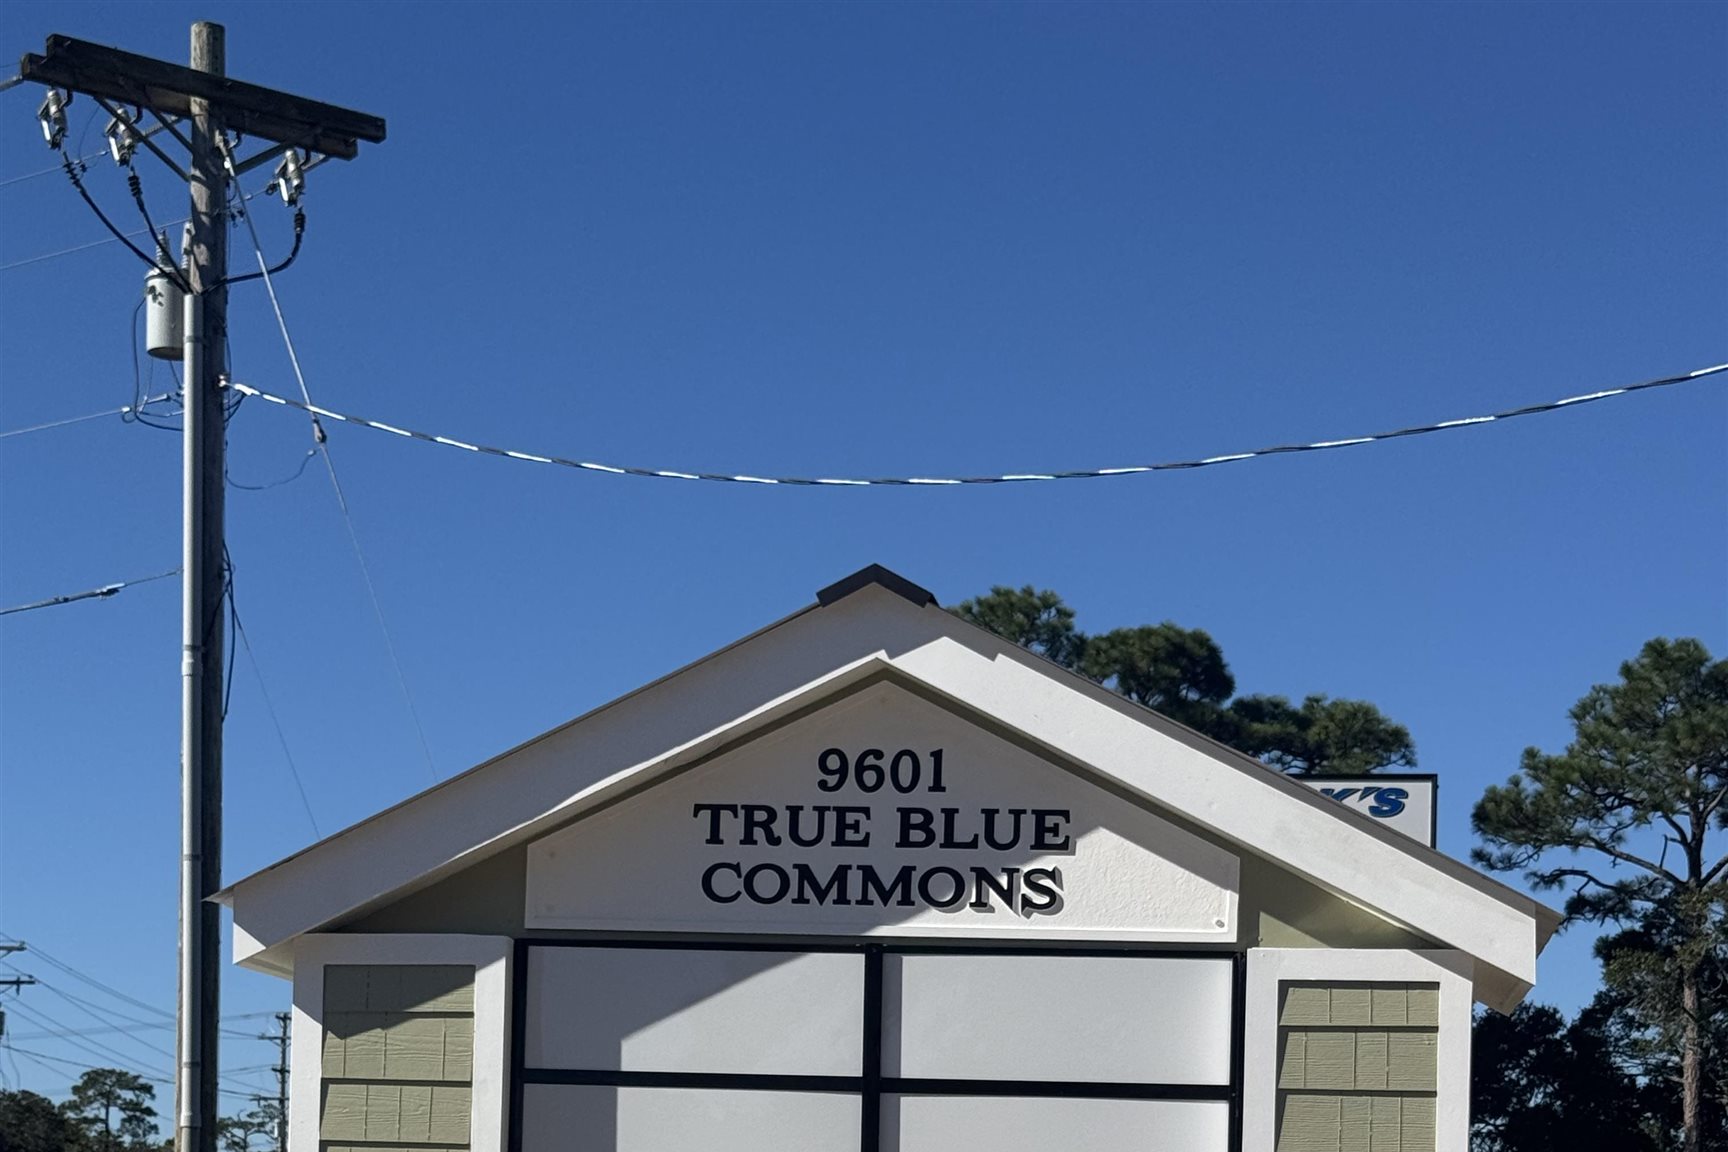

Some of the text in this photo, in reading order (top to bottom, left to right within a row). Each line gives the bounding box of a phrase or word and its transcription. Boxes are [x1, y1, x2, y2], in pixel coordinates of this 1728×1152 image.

[817, 748, 947, 793] 9601
[693, 803, 1071, 851] TRUE BLUE
[701, 861, 1058, 912] COMMONS
